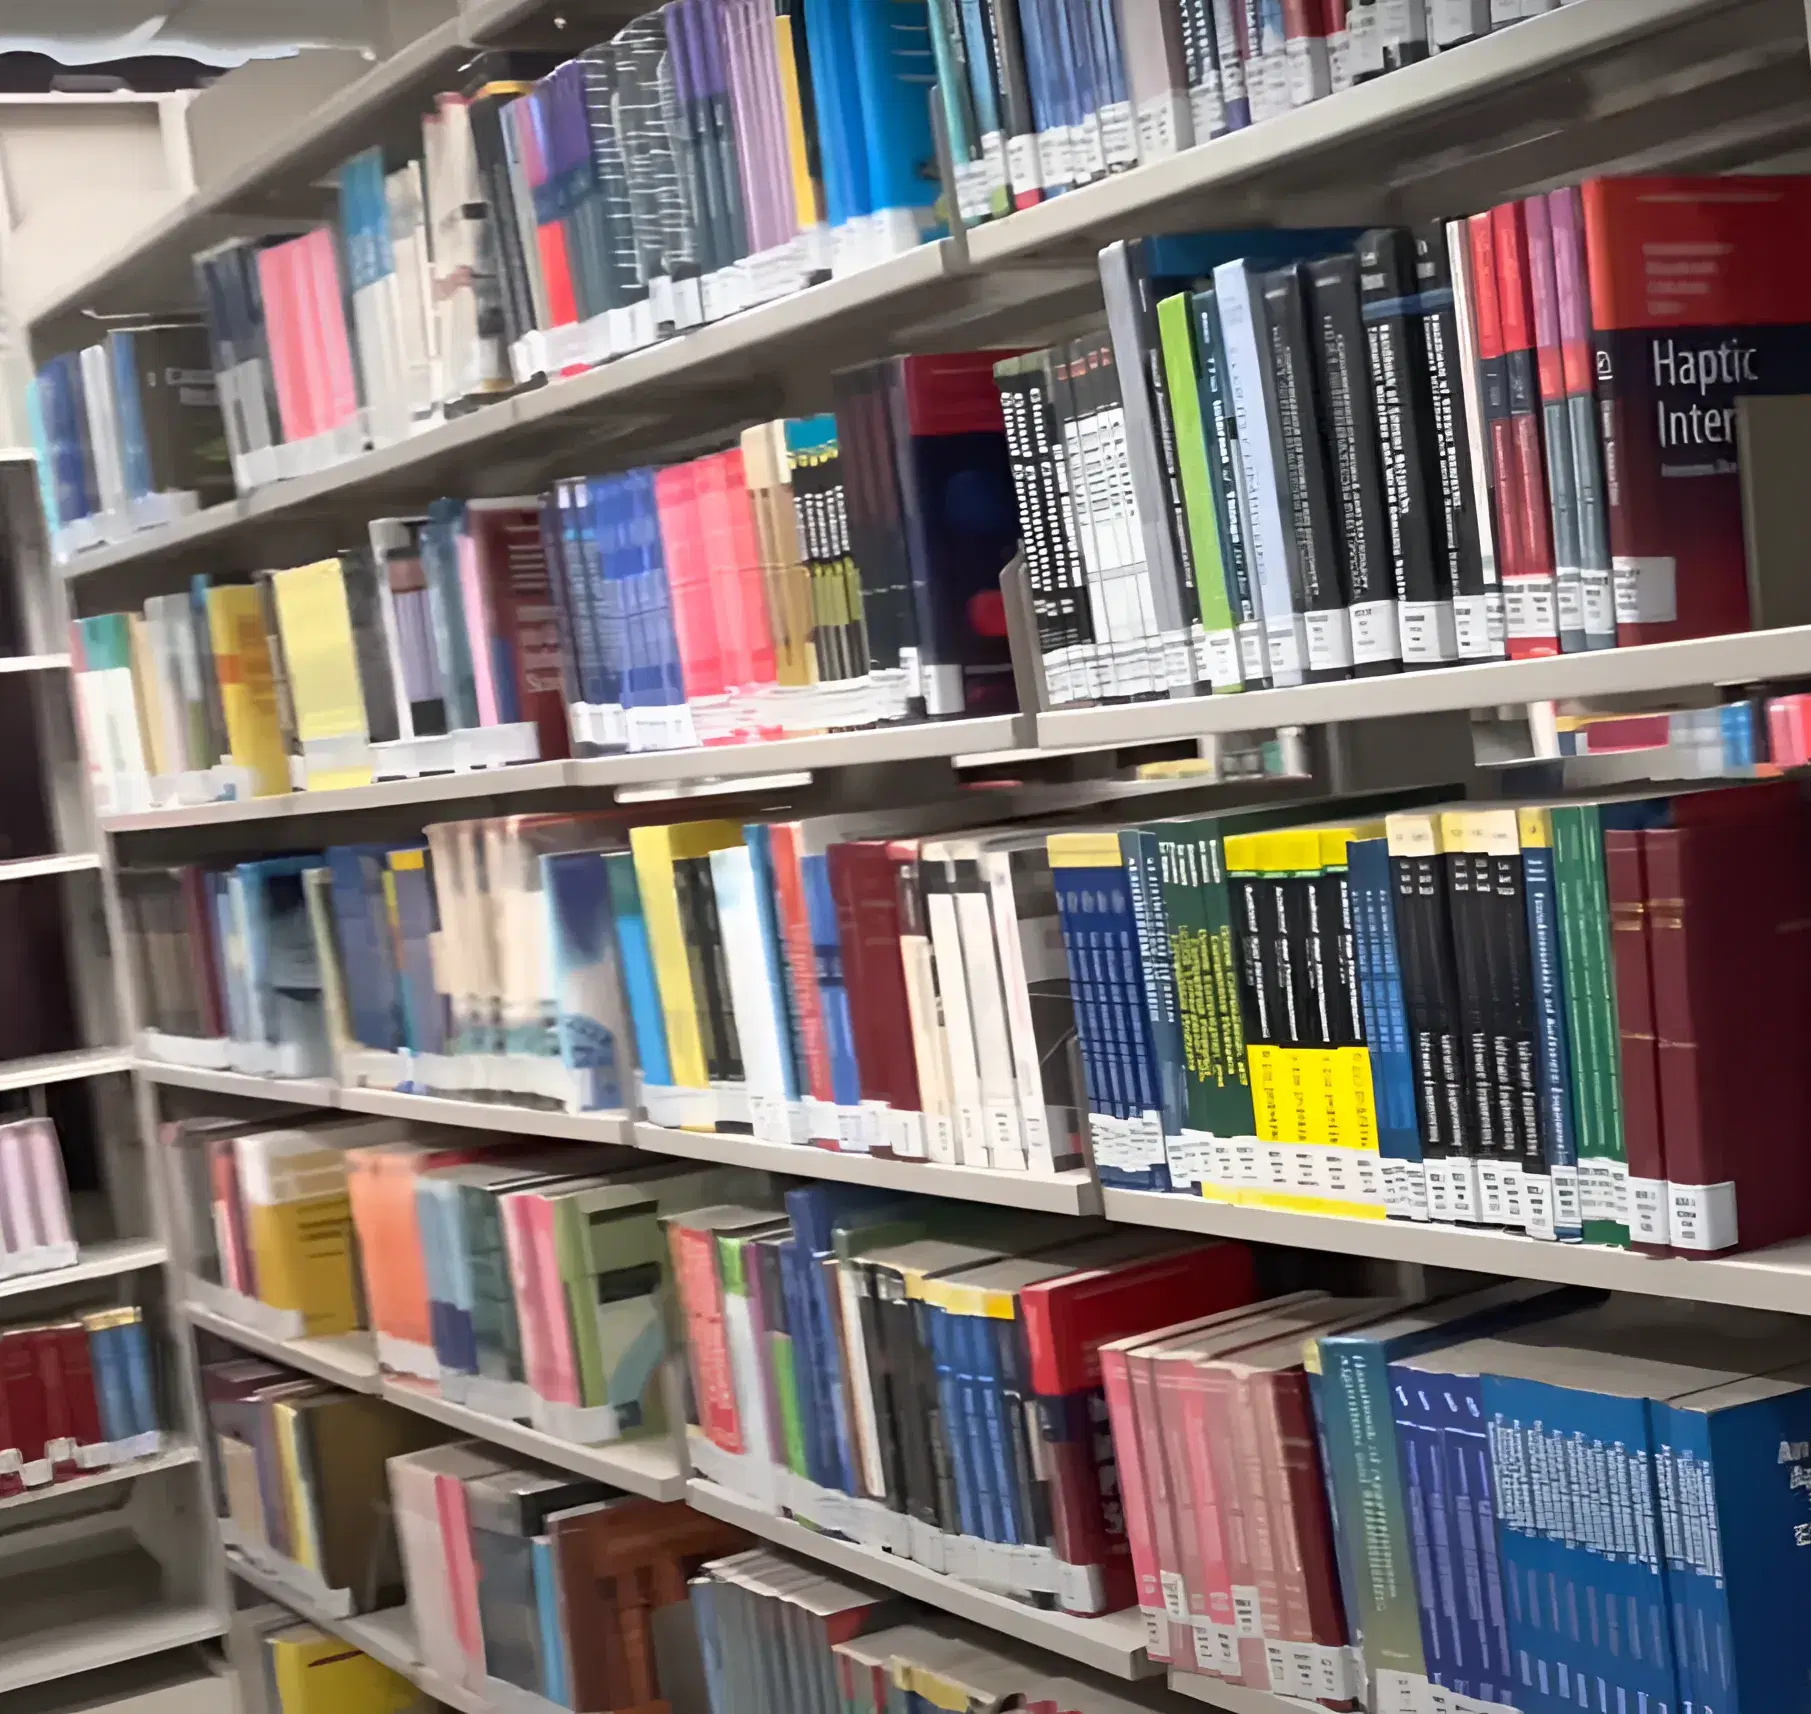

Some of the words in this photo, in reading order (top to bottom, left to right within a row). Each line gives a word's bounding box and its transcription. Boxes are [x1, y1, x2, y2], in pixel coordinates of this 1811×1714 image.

[1653, 338, 1759, 396] Haptic
[1657, 400, 1736, 448] Inter
[1777, 1439, 1810, 1464] An
